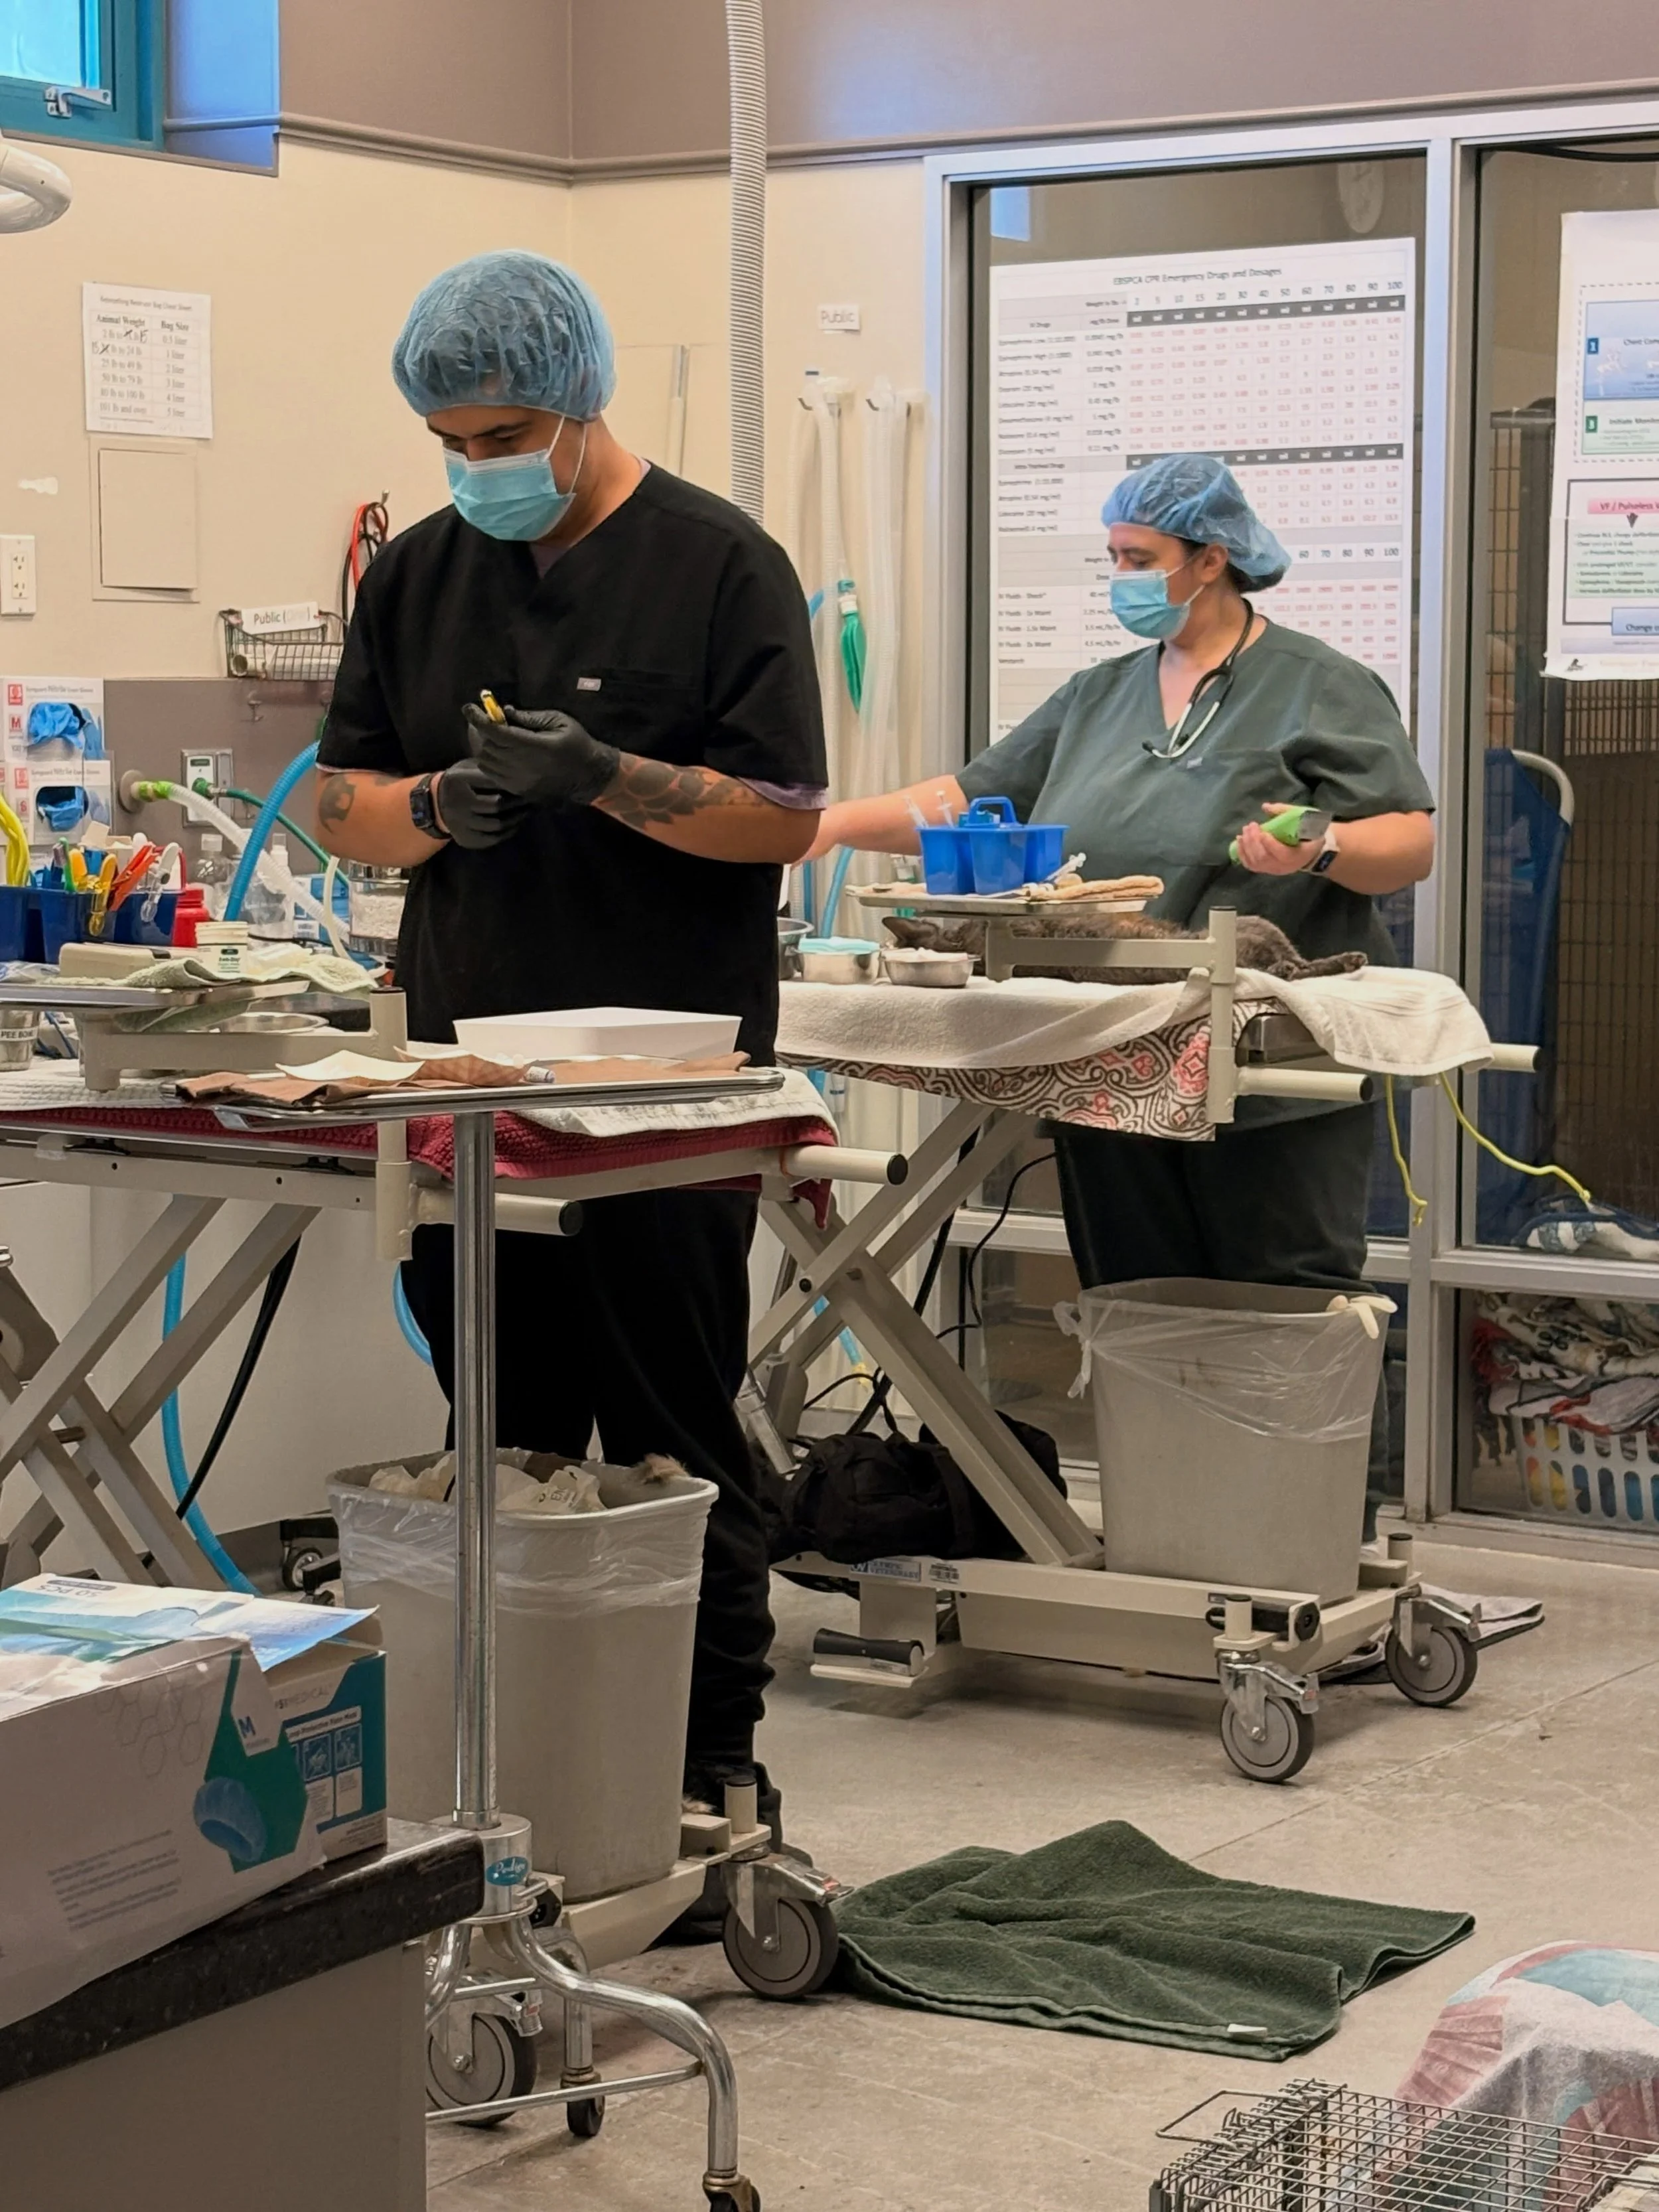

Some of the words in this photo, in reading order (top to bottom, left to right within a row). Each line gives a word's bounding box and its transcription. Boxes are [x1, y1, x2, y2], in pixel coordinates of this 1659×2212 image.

[1162, 274, 1204, 283] Emergency
[1206, 271, 1229, 281] Drugs
[1249, 268, 1282, 278] Dosages
[1259, 289, 1269, 298] 40
[1280, 288, 1291, 297] 50
[1324, 285, 1334, 294] 70
[1368, 282, 1378, 291] 90
[1388, 281, 1403, 290] 100
[96, 315, 121, 325] Animal
[123, 317, 145, 329] Weight
[820, 309, 855, 325] Public
[161, 321, 173, 331] Bag
[175, 322, 190, 331] Size
[1364, 548, 1374, 557] 90
[1384, 548, 1399, 556] 100
[253, 611, 281, 625] Public
[12, 717, 21, 727] M
[36, 1585, 73, 1594] PCS
[238, 1716, 256, 1738] M
